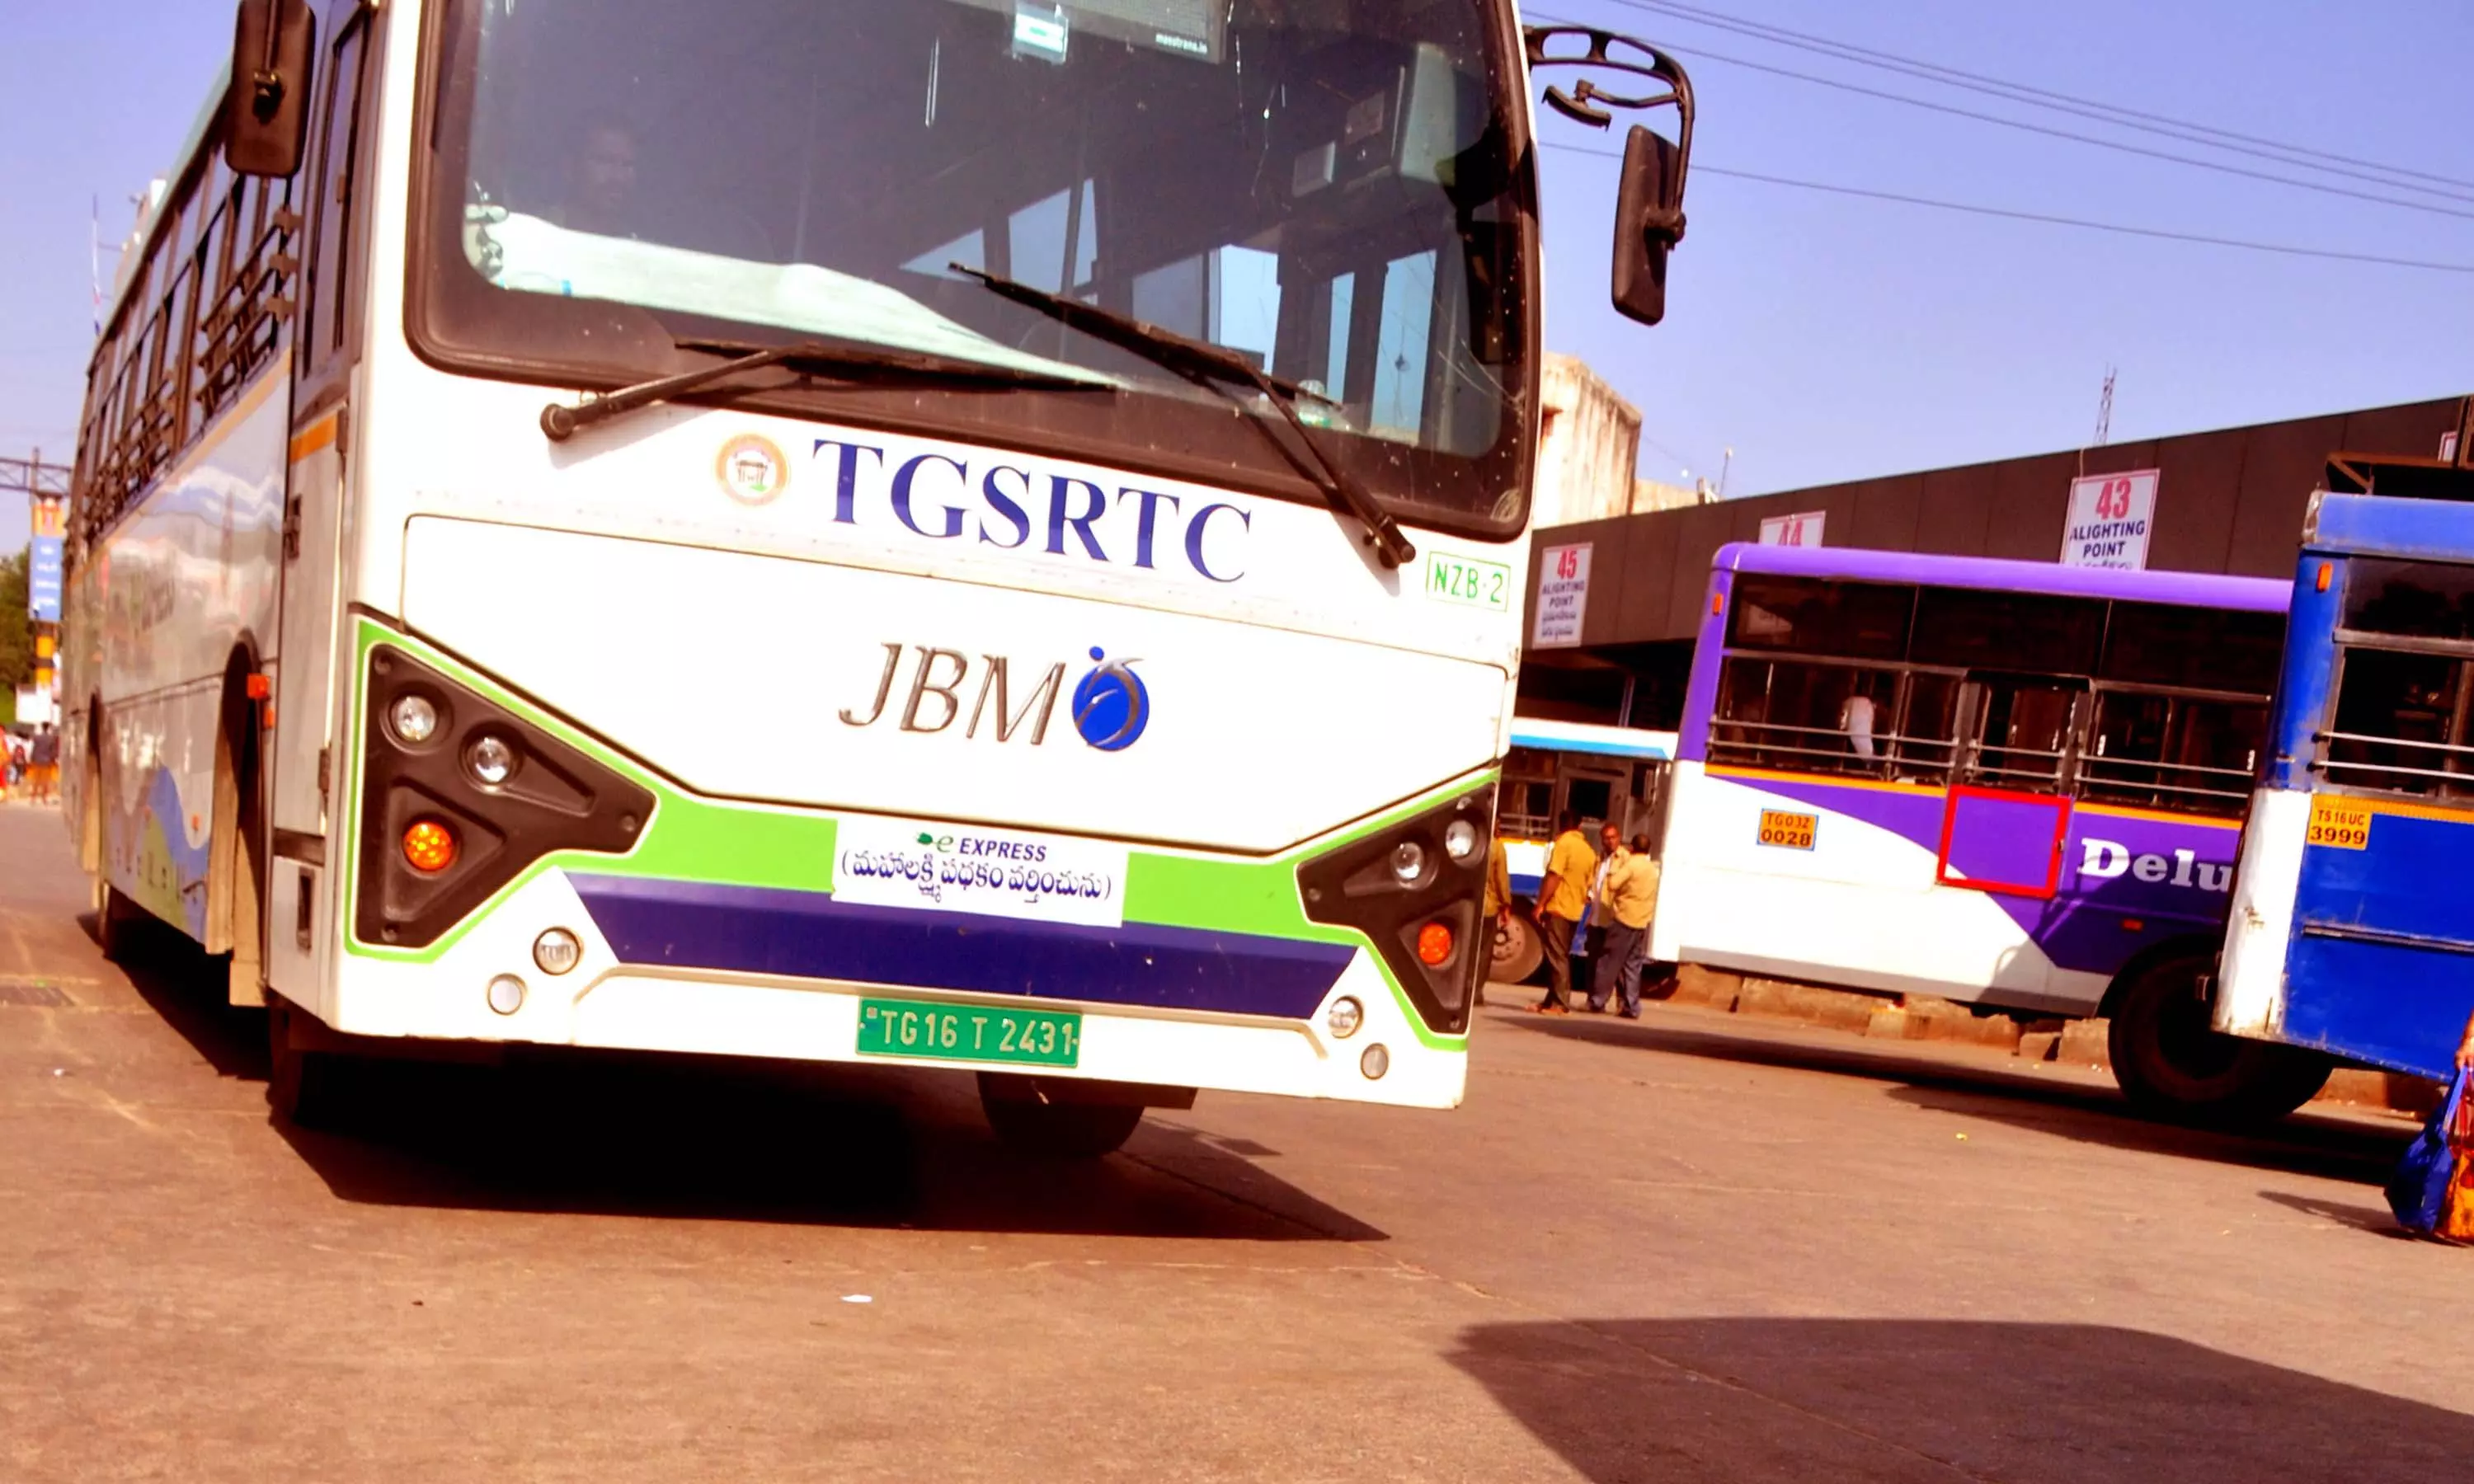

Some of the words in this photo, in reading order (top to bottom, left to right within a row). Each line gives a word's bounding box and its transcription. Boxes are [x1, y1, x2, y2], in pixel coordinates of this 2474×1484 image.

[812, 439, 1252, 583] TGSRTC
[2095, 478, 2132, 520] 43
[2069, 520, 2145, 541] ALIGHTING
[1557, 549, 1578, 579] 45
[2083, 541, 2126, 559] POINT
[838, 641, 1066, 745] JBM
[959, 837, 1047, 862] EXPRESS
[1761, 827, 1812, 848] 0028
[2310, 825, 2366, 844] 3999
[2077, 837, 2232, 893] Delu
[999, 1017, 1074, 1055] 2431
